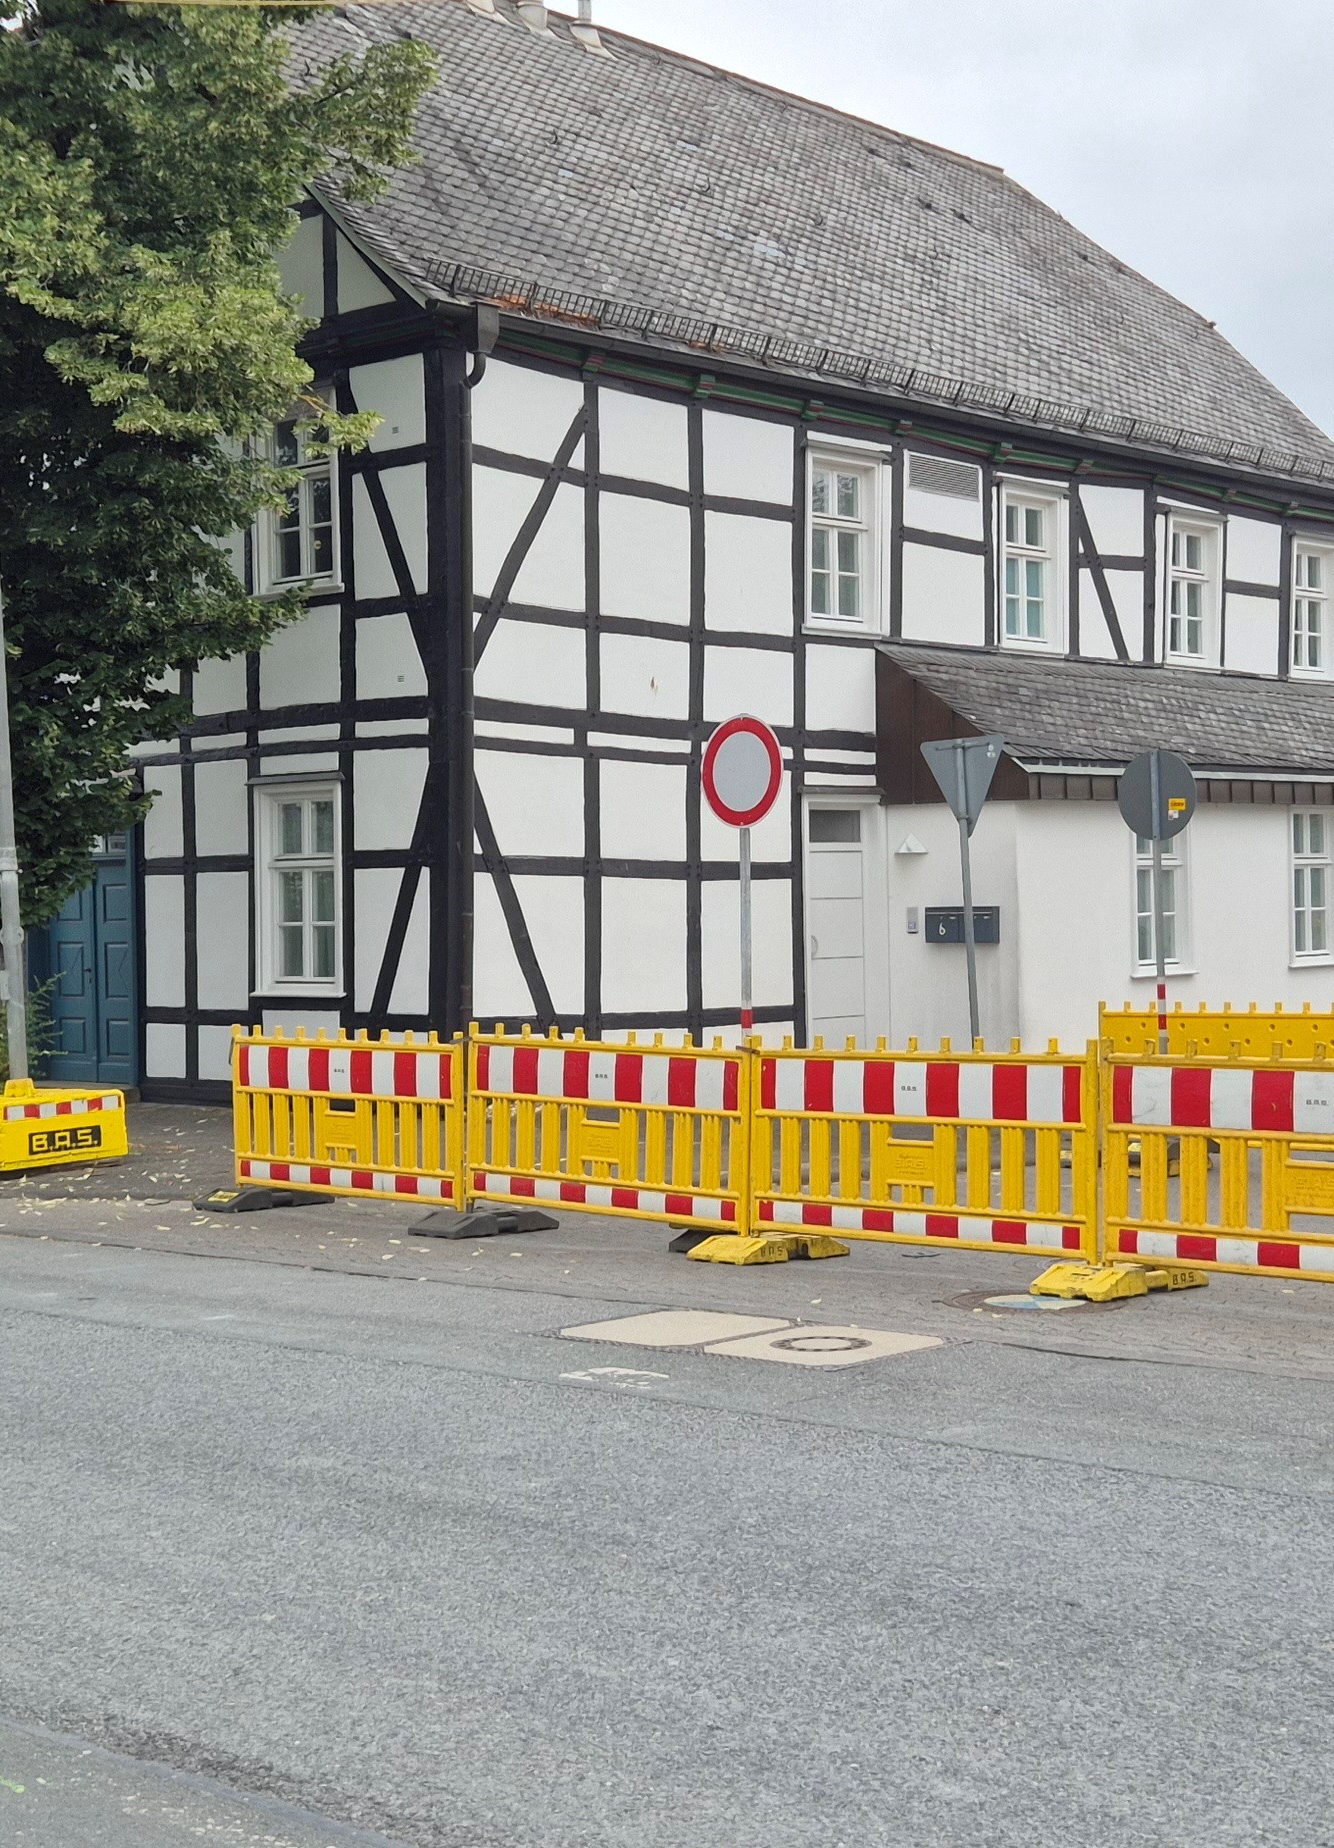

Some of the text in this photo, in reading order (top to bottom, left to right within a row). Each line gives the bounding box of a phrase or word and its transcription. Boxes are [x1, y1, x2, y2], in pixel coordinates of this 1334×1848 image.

[939, 922, 946, 935] 6
[32, 1129, 98, 1152] B.A.S.
[1172, 1272, 1197, 1286] B.A.S.
